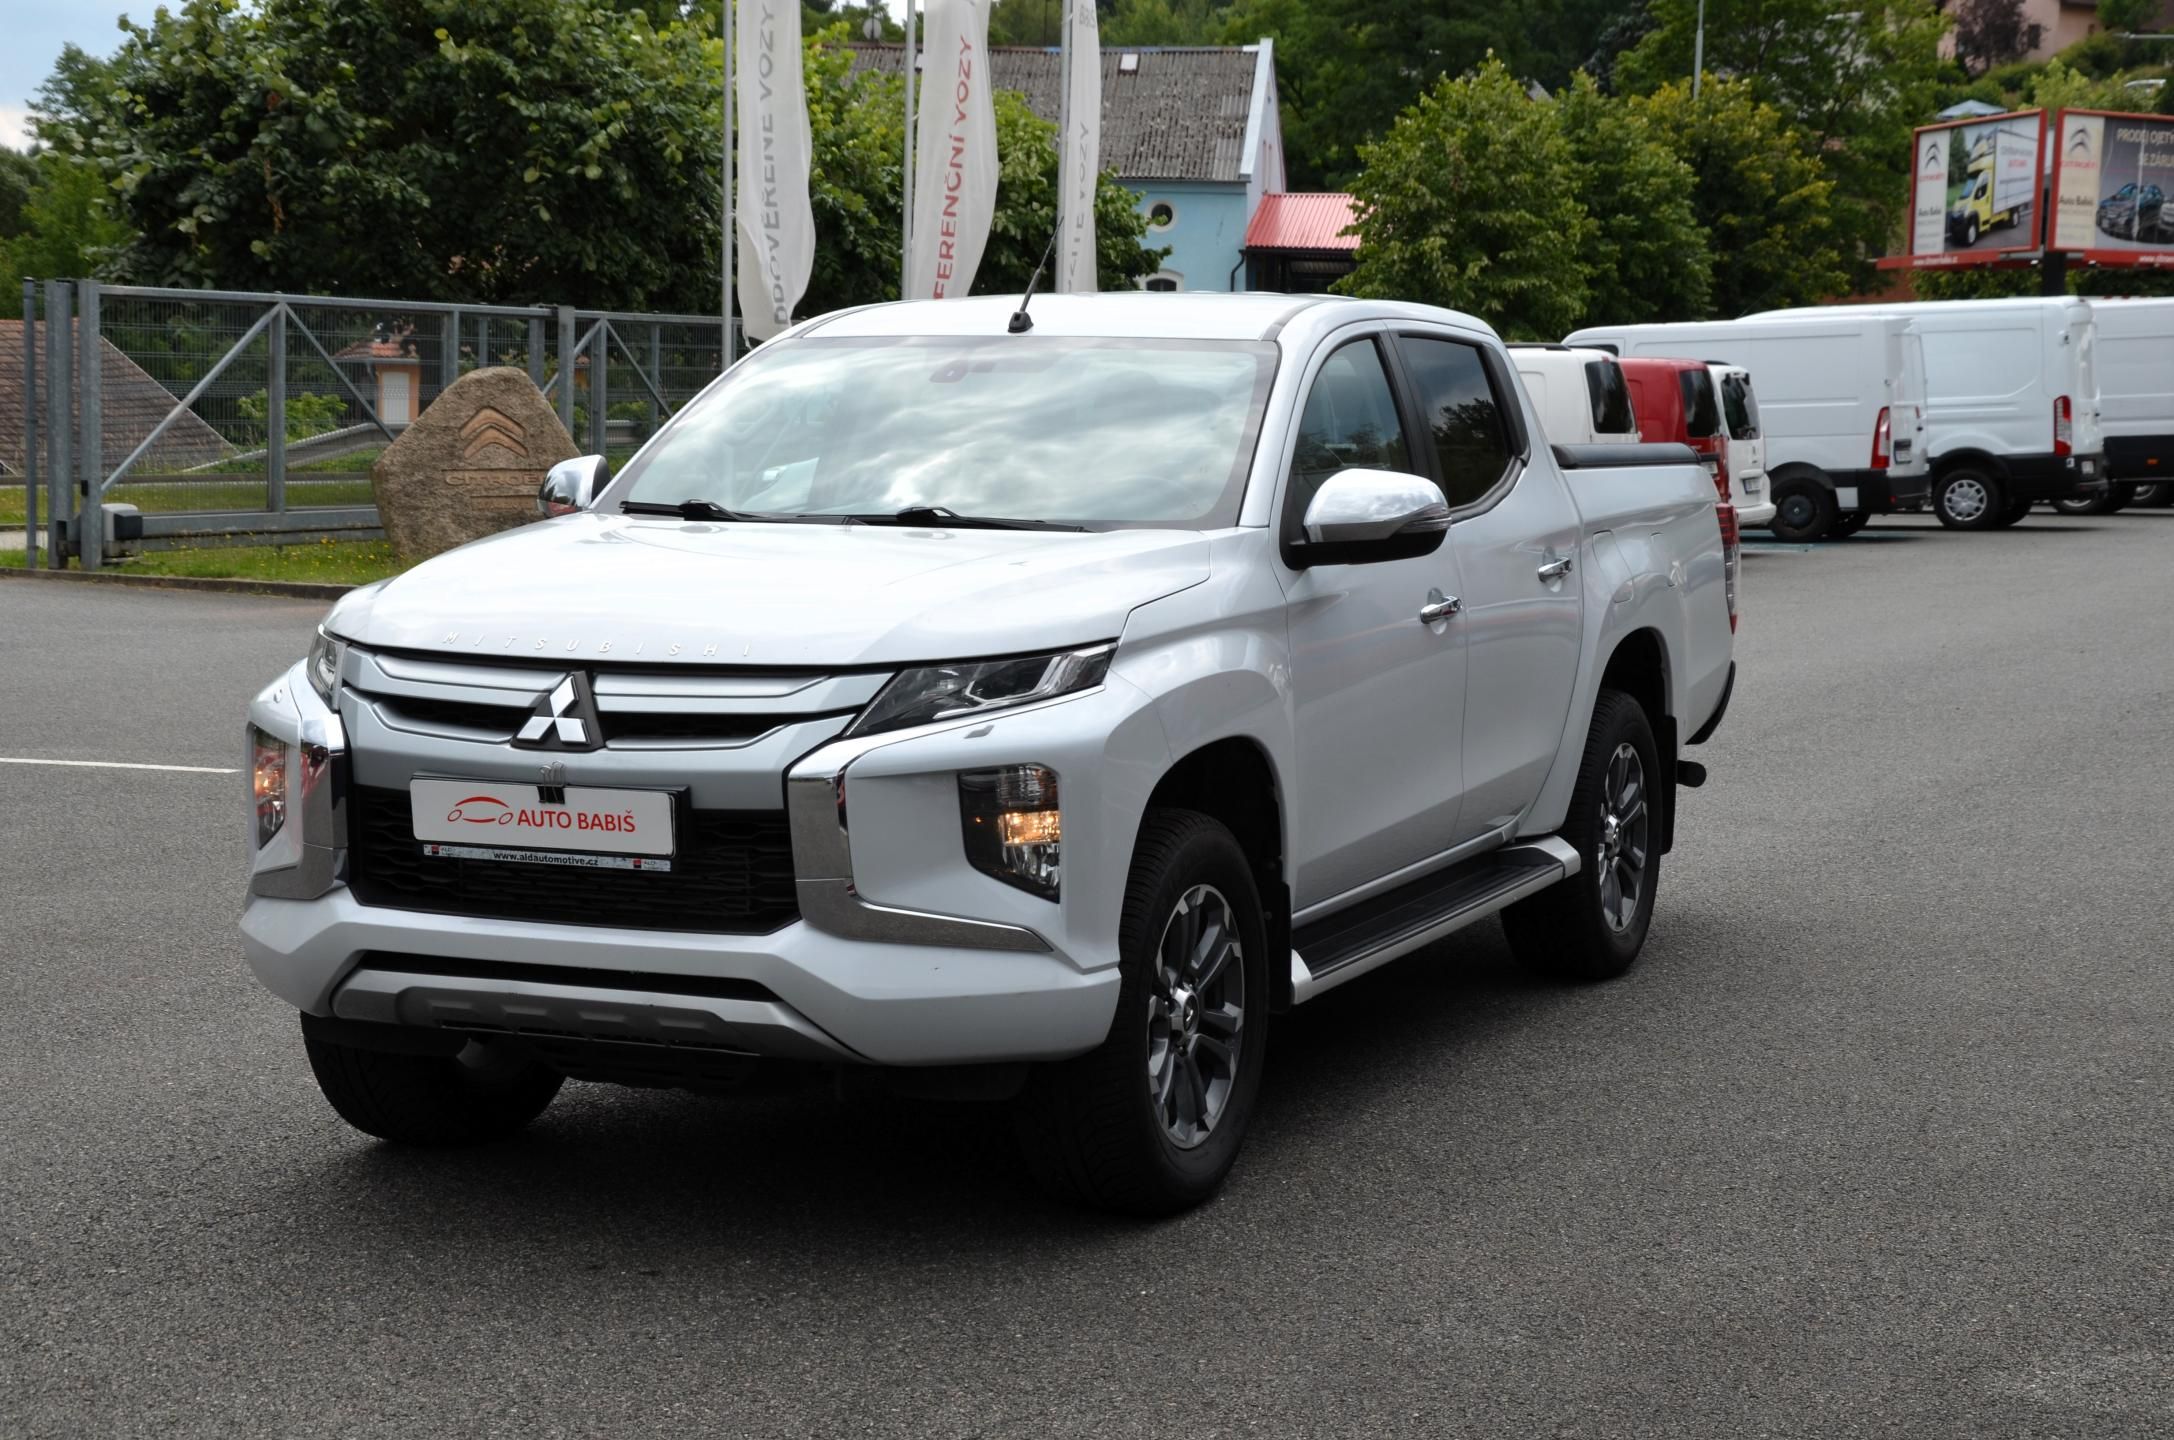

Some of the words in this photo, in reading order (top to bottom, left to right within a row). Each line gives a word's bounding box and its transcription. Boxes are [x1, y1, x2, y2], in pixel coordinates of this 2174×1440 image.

[759, 2, 775, 101] VOZY
[955, 35, 972, 126] VOZY
[442, 631, 749, 657] MITSUBISHI
[517, 809, 572, 829] AUTO
[577, 810, 636, 833] BABIŠ
[493, 851, 599, 867] www.aldautomotive.cz
